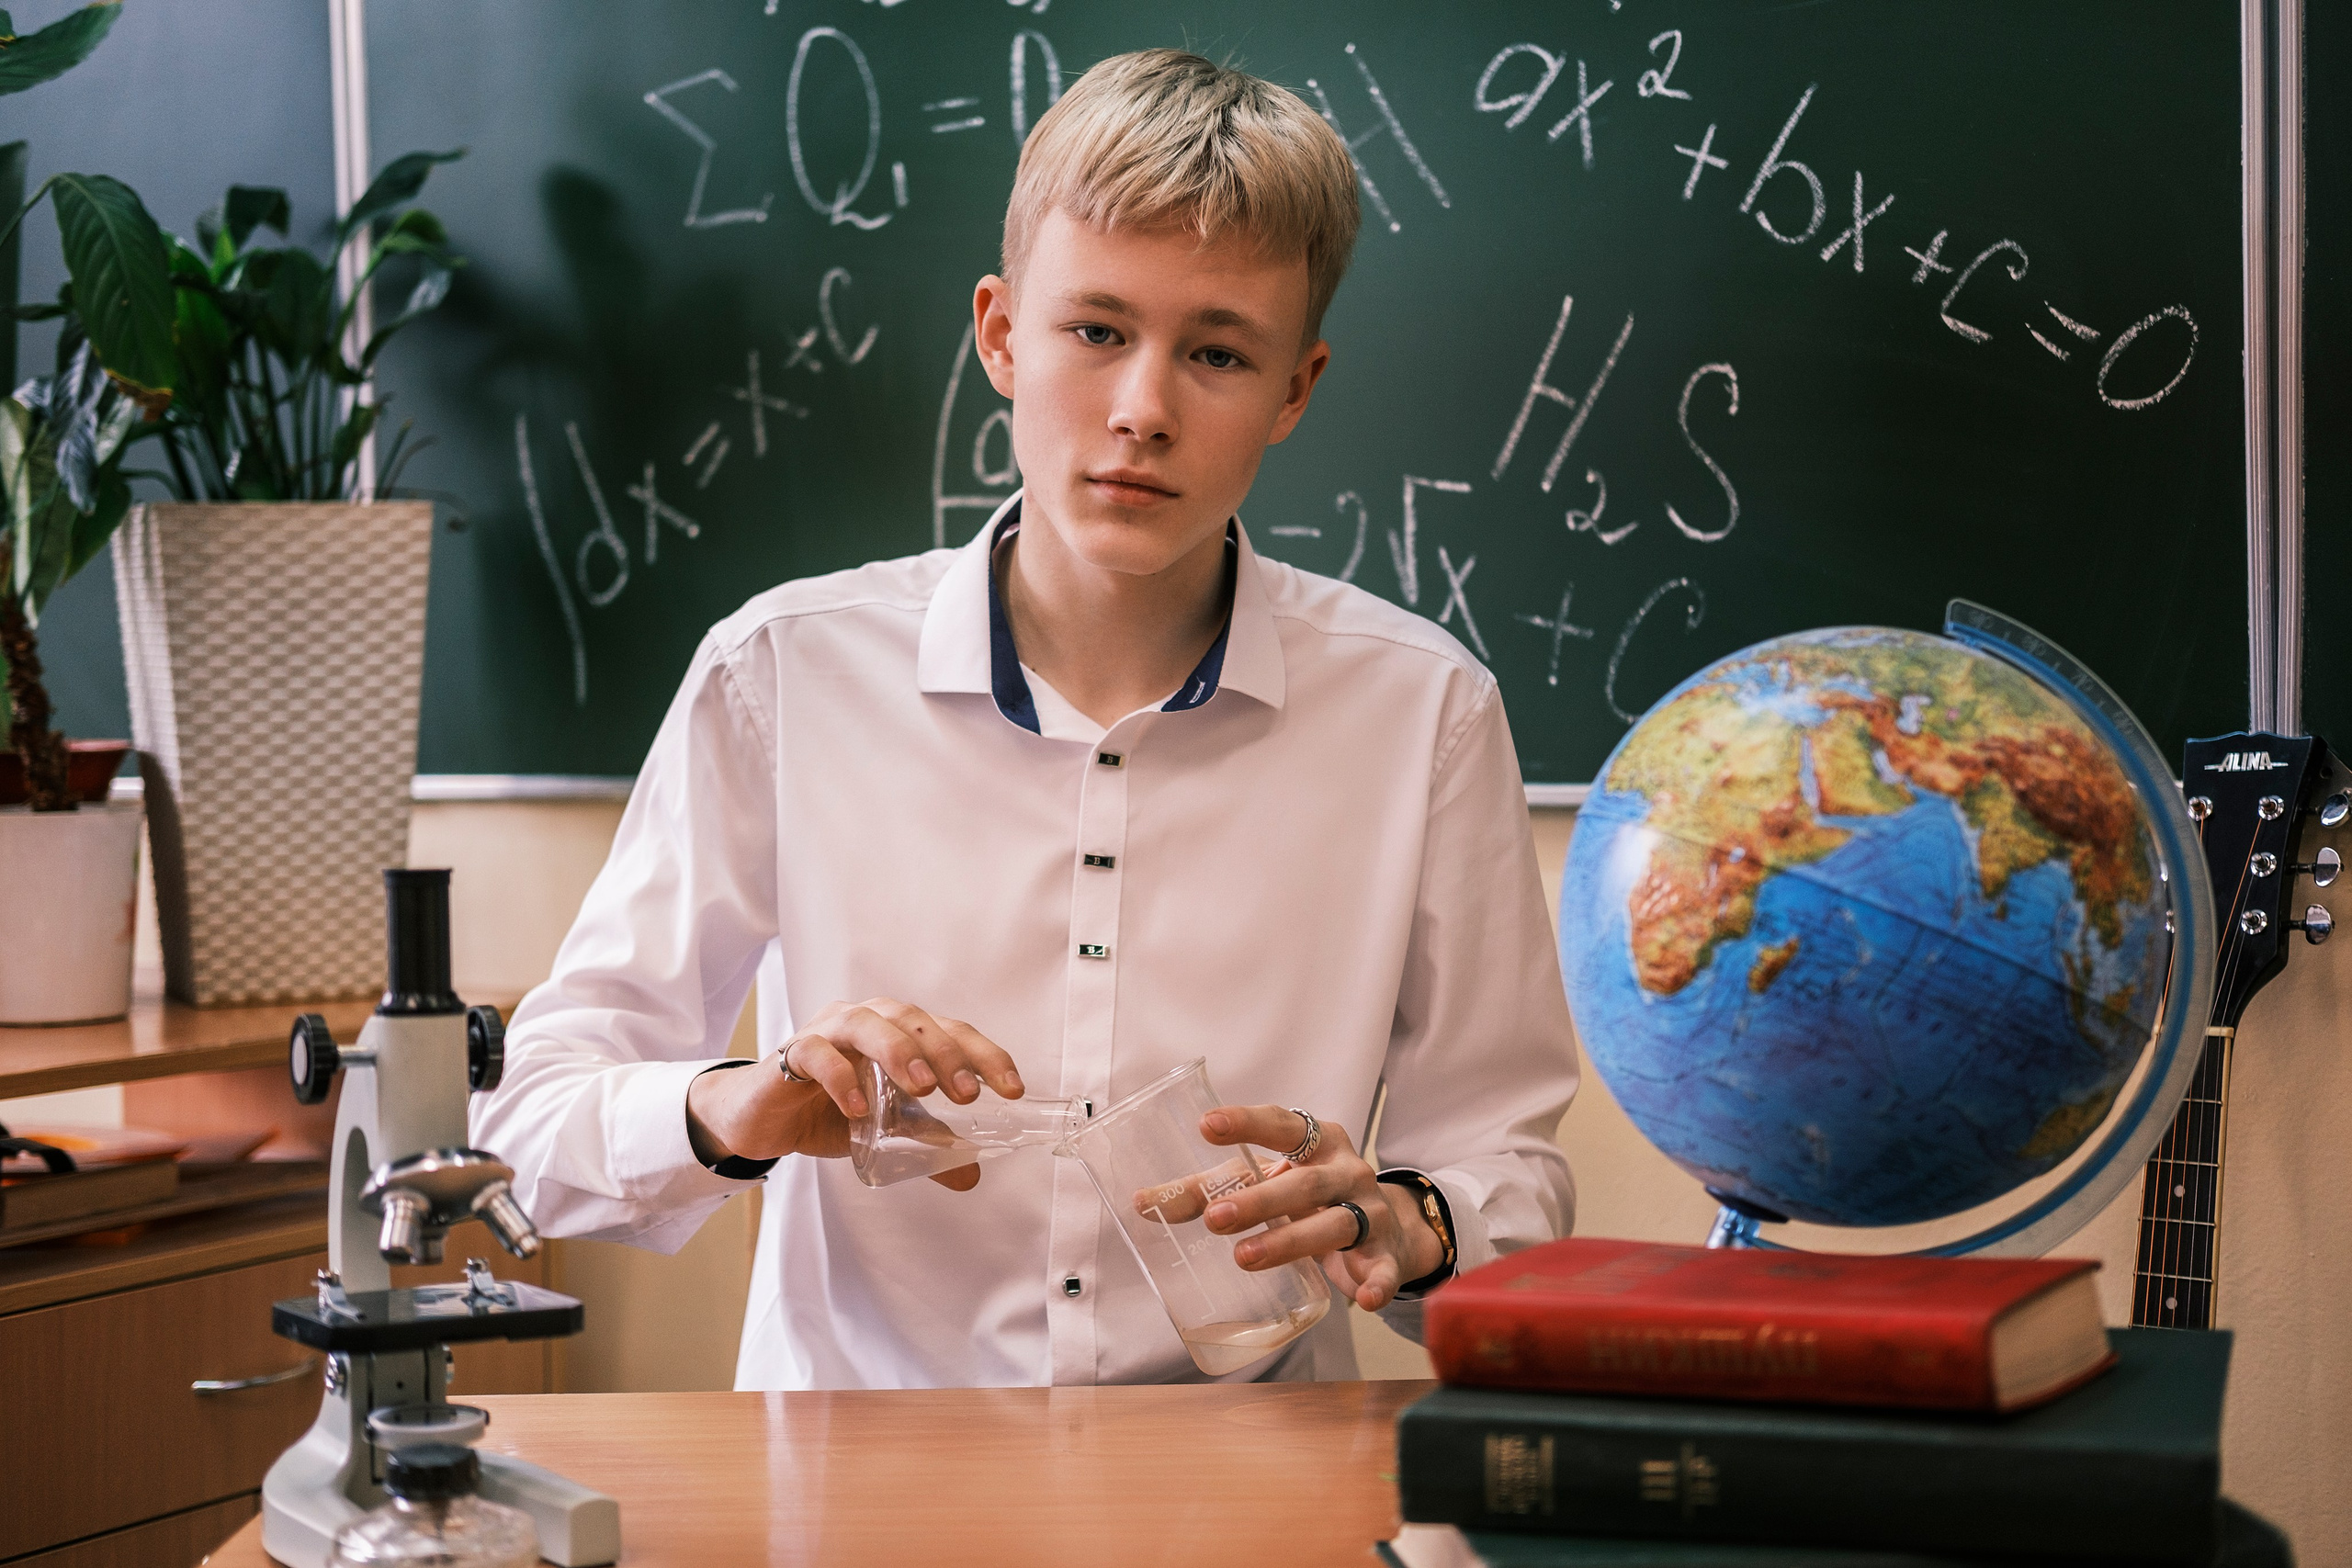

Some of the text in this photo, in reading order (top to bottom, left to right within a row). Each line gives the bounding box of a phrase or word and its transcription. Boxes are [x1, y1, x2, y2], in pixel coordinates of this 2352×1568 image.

[2217, 750, 2274, 773] ALINA
[1158, 1183, 1185, 1203] 300
[1187, 1234, 1217, 1257] 200
